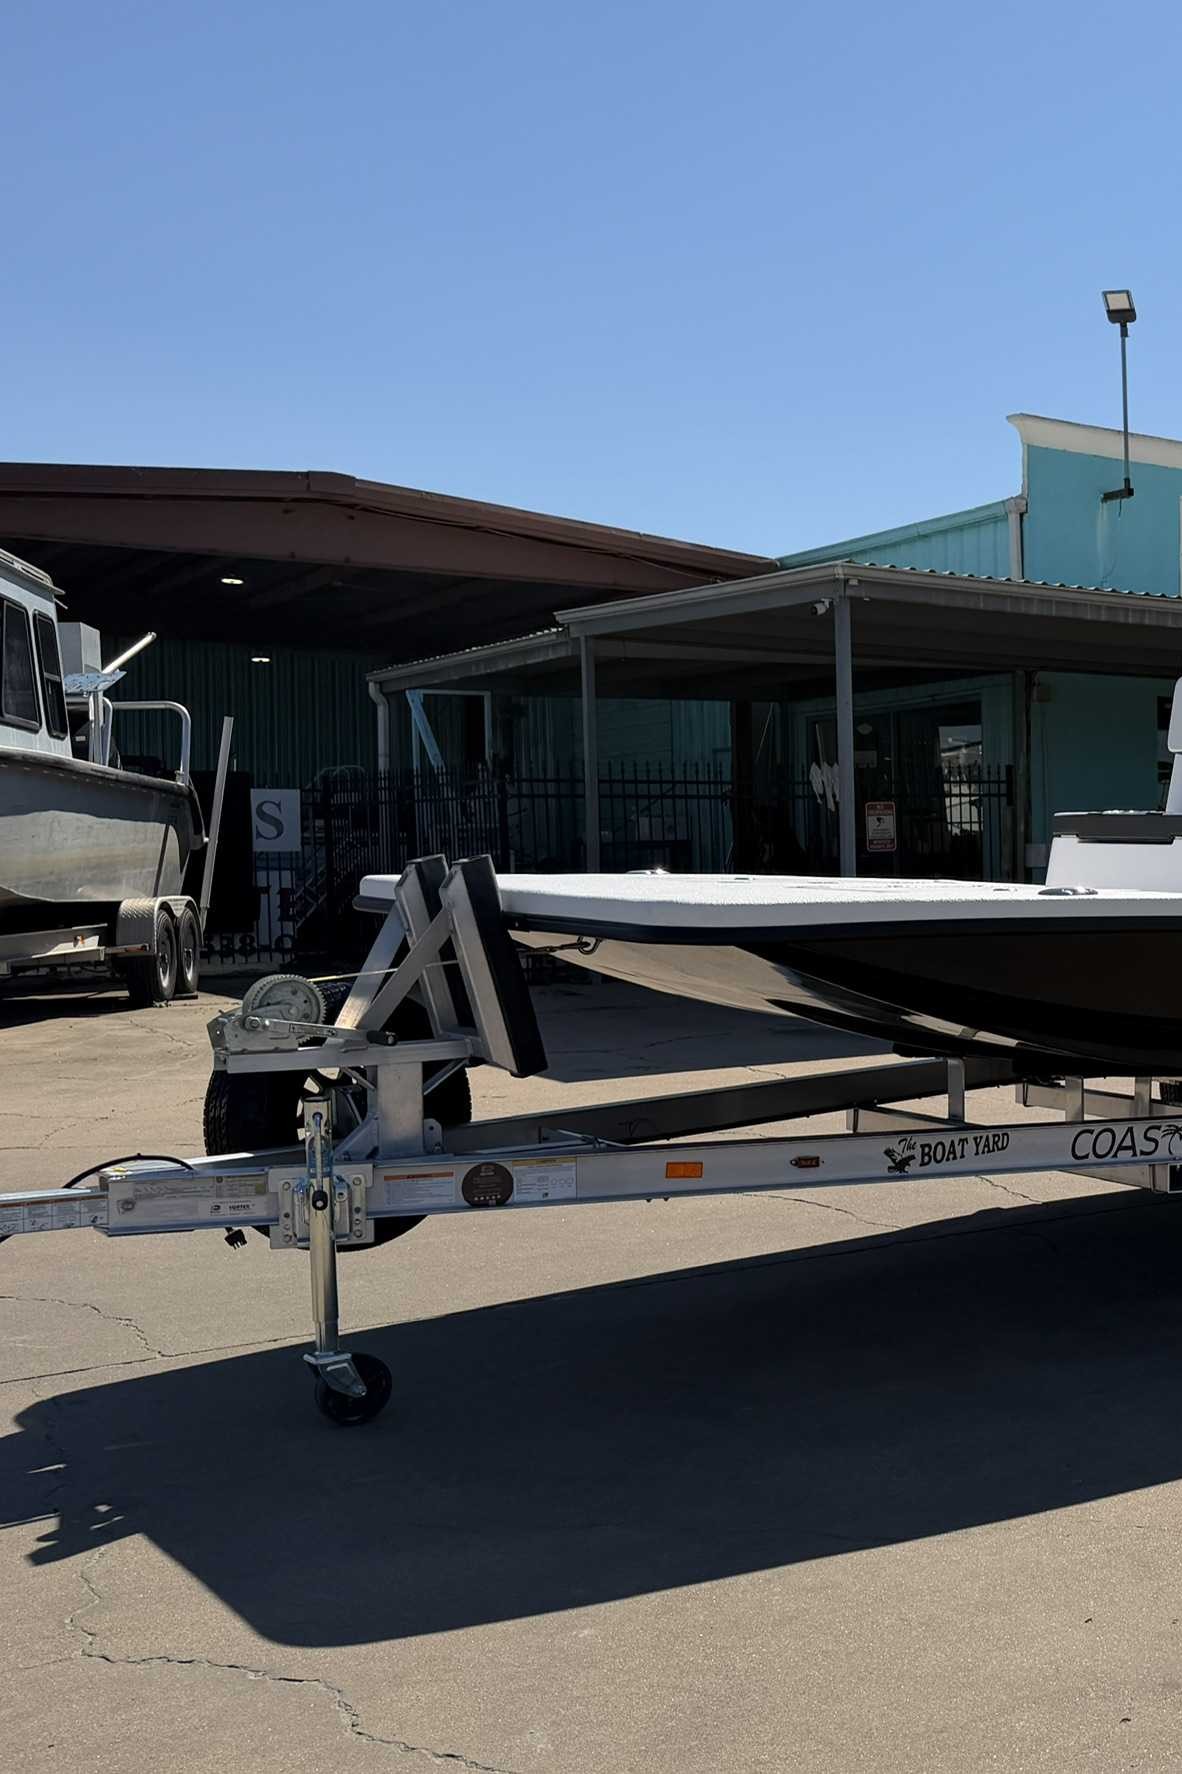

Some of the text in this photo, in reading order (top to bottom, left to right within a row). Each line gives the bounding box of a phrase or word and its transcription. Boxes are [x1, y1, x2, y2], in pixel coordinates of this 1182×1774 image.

[255, 800, 285, 841] S
[898, 1135, 918, 1154] The
[918, 1132, 1010, 1168] BOAT YARD
